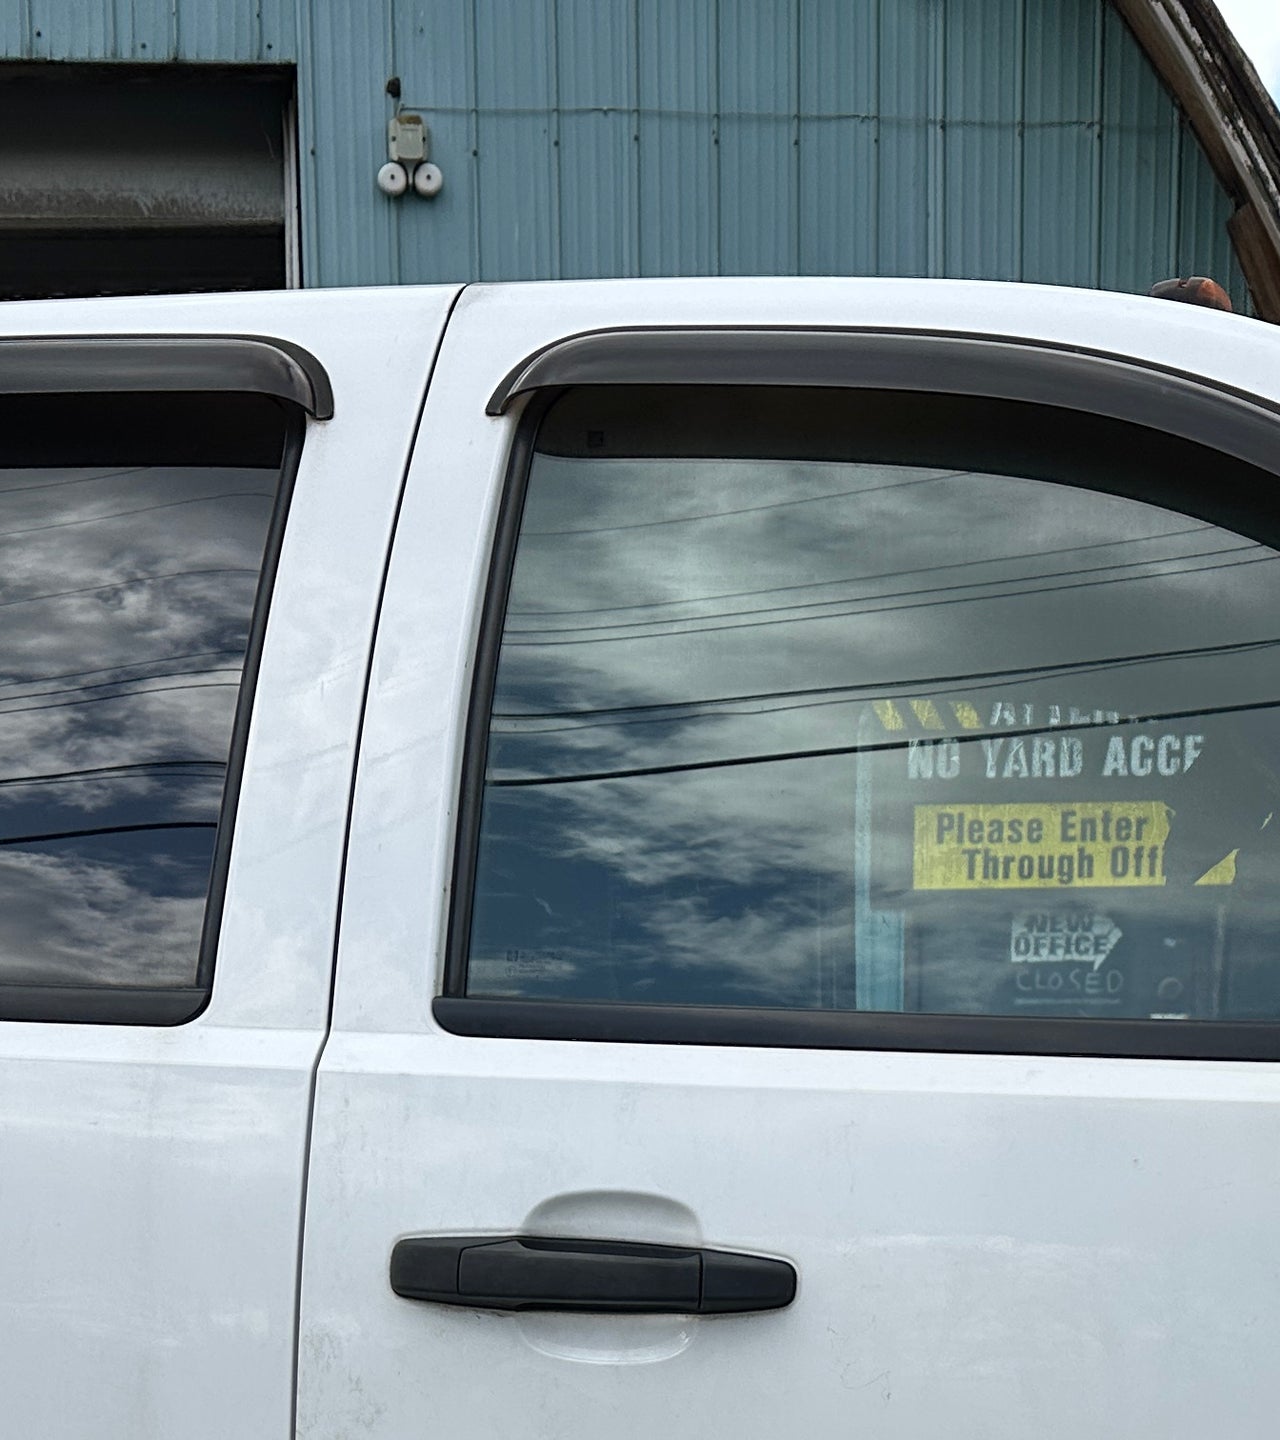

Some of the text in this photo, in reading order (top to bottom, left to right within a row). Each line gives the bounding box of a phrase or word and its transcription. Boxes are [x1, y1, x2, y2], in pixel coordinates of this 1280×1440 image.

[907, 736, 961, 780] NO
[980, 736, 1084, 779] YARD
[936, 809, 1149, 844] Please Enter
[961, 847, 1094, 884] Through
[1013, 931, 1110, 956] OFFICE
[1016, 968, 1124, 995] CLOSED
